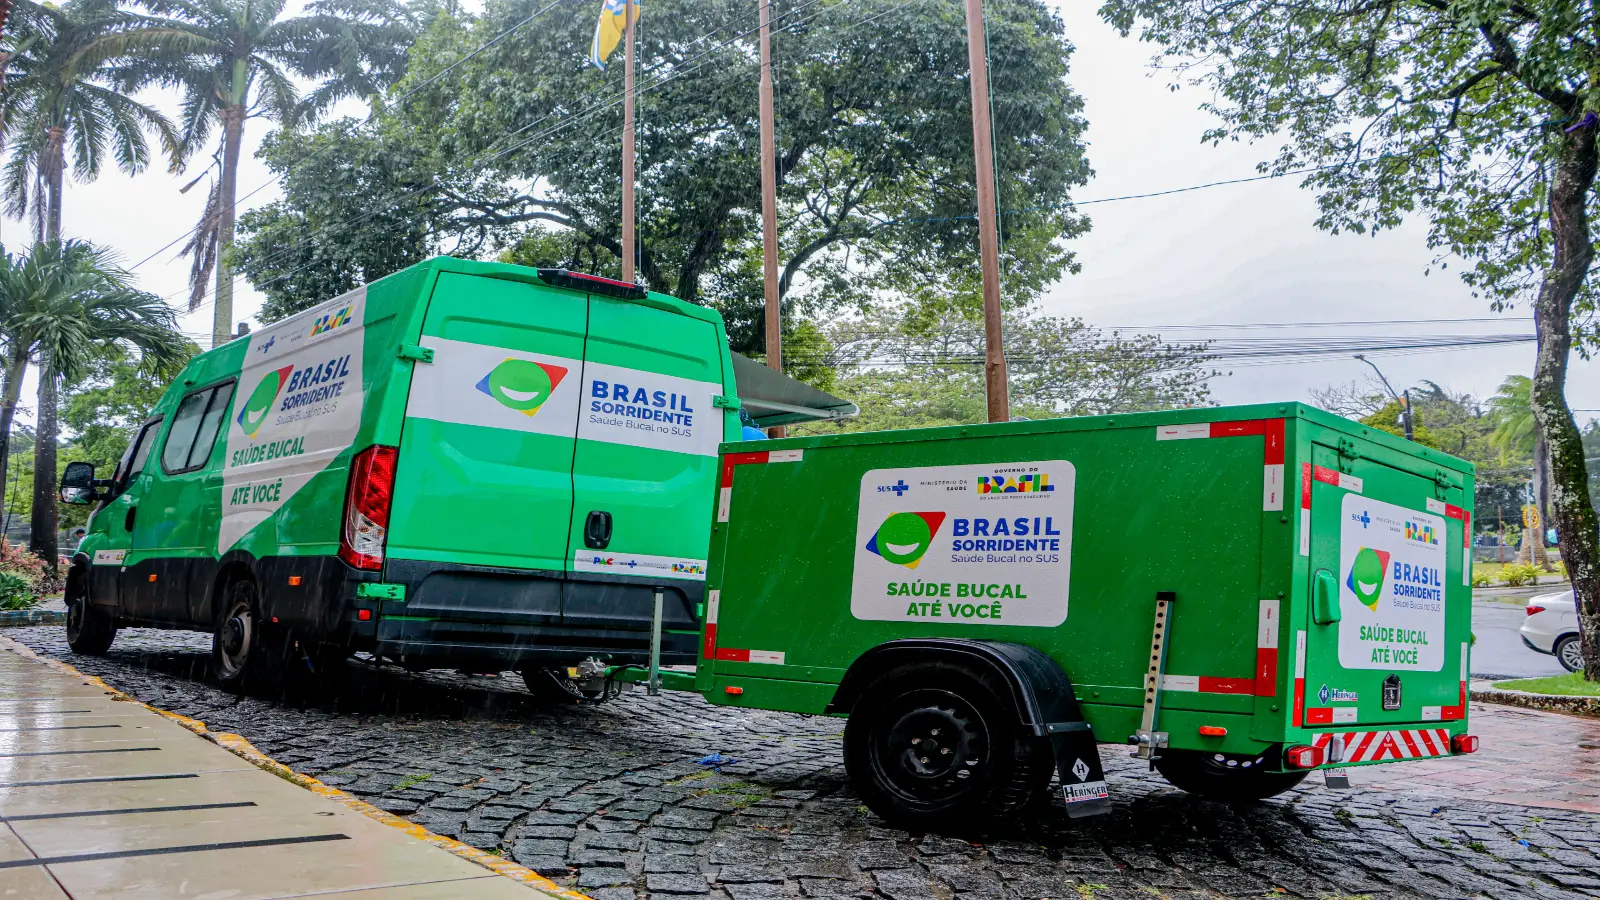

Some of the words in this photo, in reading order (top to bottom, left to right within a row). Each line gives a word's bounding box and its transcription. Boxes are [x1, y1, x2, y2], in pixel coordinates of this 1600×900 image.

[287, 354, 351, 394] BRASIL
[280, 380, 345, 412] SORRIDENTE
[591, 380, 694, 413] BRASIL
[321, 400, 338, 416] SUS
[590, 400, 693, 427] SORRIDENTE
[589, 414, 624, 427] Saúde
[625, 419, 655, 432] Bucal
[656, 426, 669, 434] no
[671, 426, 692, 438] SUS
[231, 442, 267, 468] SAÚDE
[267, 436, 305, 459] BUCAL
[230, 482, 252, 506] ATÉ
[252, 477, 283, 503] VOCÊ
[877, 485, 892, 493] SUS
[977, 474, 1055, 494] BRASIL
[952, 517, 1061, 537] BRASIL
[952, 538, 1060, 552] SORRIDENTE
[593, 556, 614, 566] PAC
[951, 554, 984, 563] Saúde
[987, 554, 1016, 563] Bucal
[1035, 554, 1059, 563] SUS
[1393, 561, 1441, 587] BRASIL
[886, 578, 952, 597] SAÚDE
[957, 583, 1028, 599] BUCAL
[1393, 583, 1441, 601] SORRIDENTE
[906, 599, 942, 617] ATÉ
[948, 600, 1002, 619] VOCÊ
[1393, 598, 1409, 609] Saúde
[1410, 600, 1424, 611] Bucal
[1431, 603, 1441, 612] SUS
[1359, 622, 1394, 643] SAÚDE
[1396, 628, 1428, 645] BUCAL
[1371, 645, 1390, 664] ATÉ
[1392, 646, 1418, 665] VOCÊ
[1076, 764, 1085, 773] H
